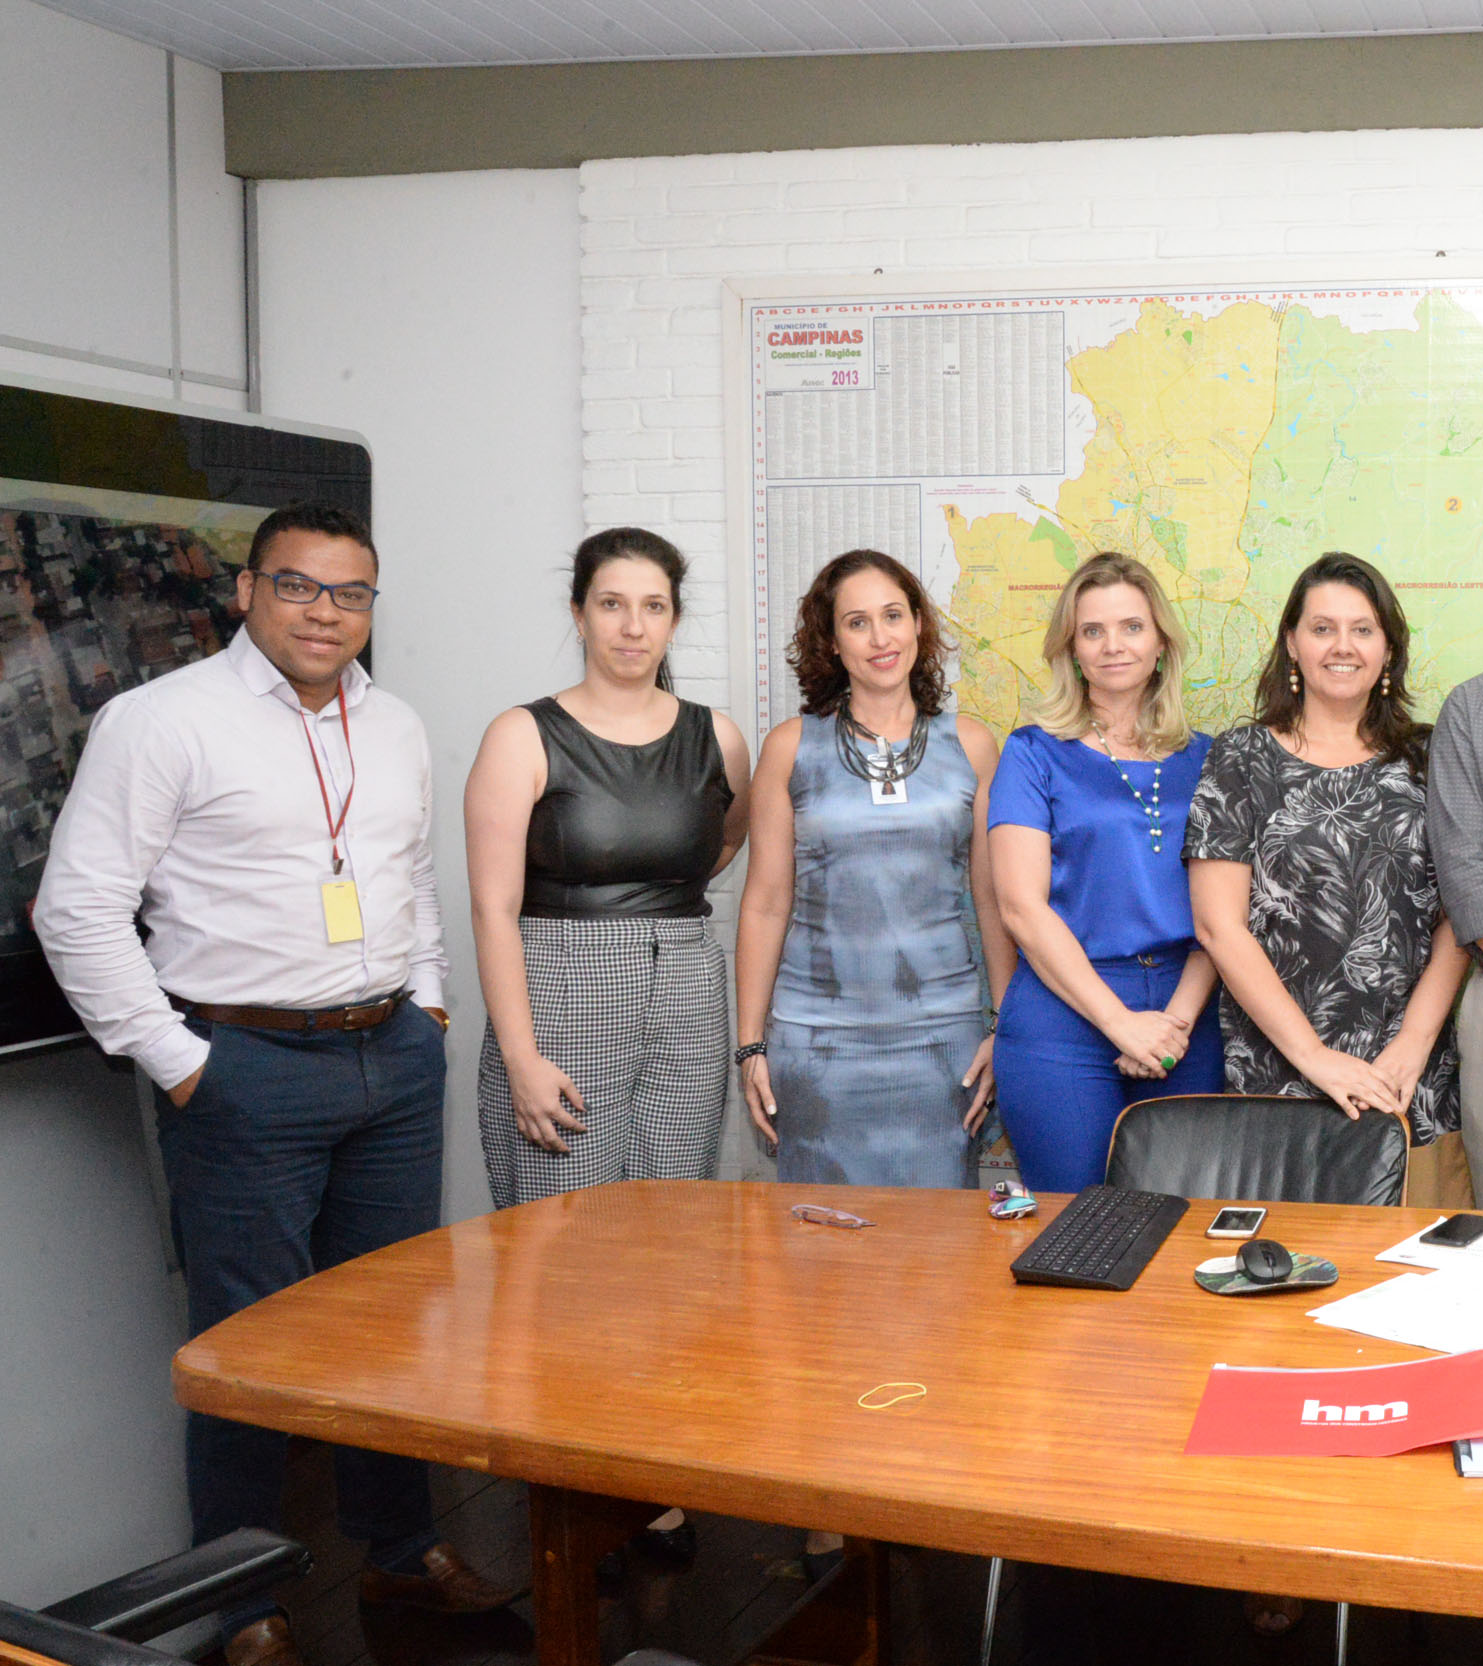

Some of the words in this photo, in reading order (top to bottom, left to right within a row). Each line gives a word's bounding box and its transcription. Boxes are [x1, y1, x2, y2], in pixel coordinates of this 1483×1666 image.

[767, 329, 864, 346] CAMPINAS
[771, 349, 817, 359] Comercial
[825, 348, 862, 360] Regiões
[832, 370, 859, 386] 2013
[1448, 498, 1458, 511] 2
[948, 506, 955, 518] 1
[1302, 1399, 1409, 1421] hm
